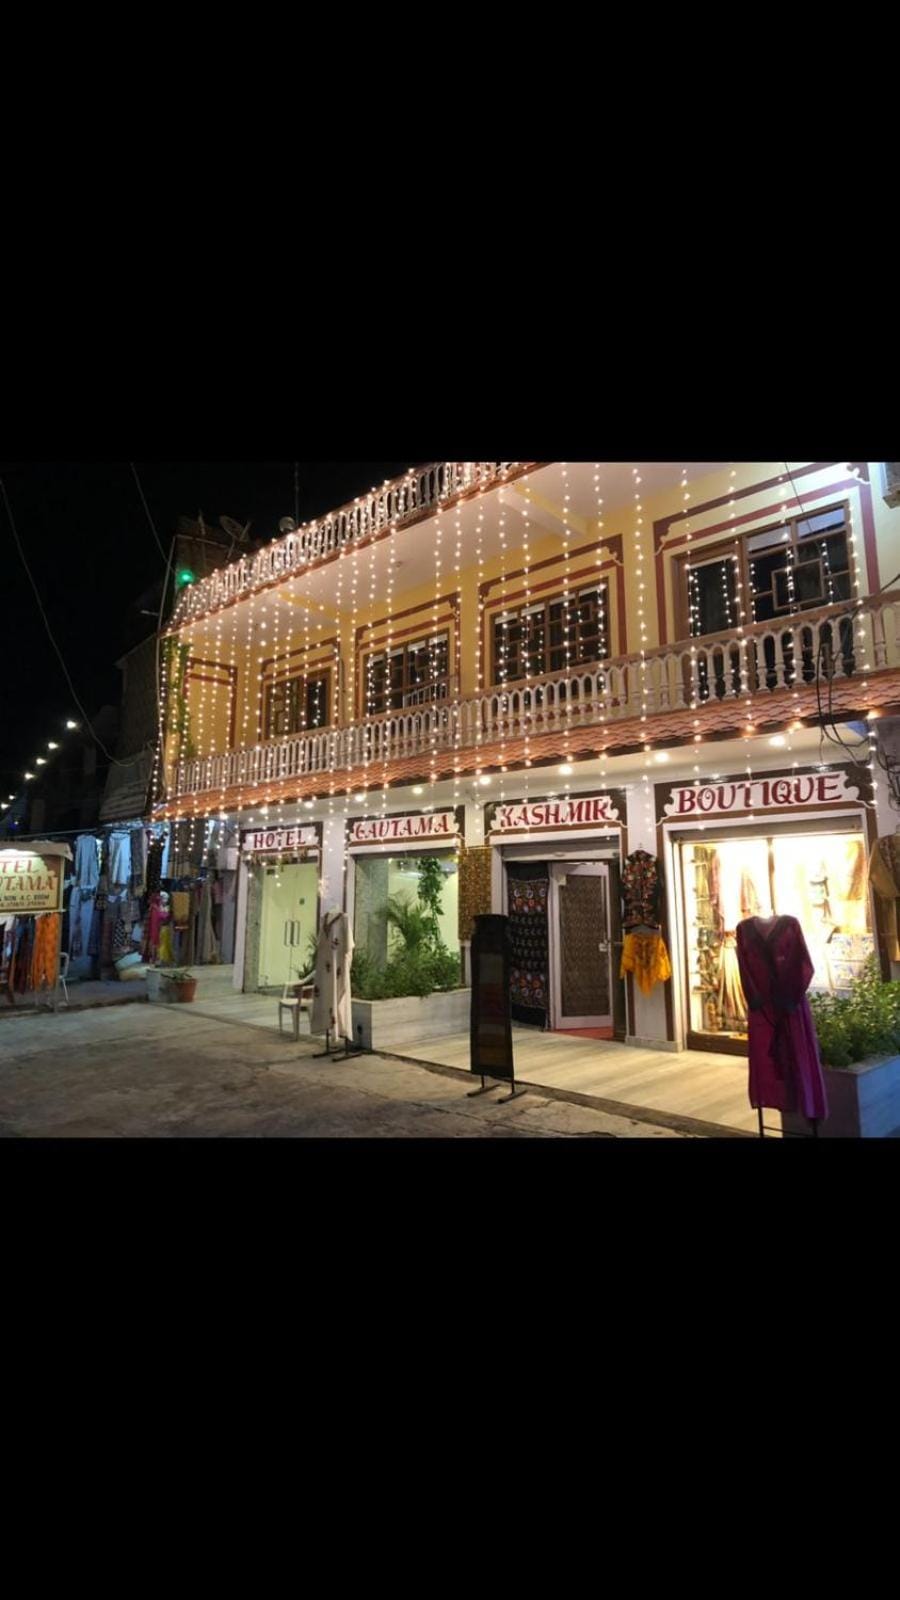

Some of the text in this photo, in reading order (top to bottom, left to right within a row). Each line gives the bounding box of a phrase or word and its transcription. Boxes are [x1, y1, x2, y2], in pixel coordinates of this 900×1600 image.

[676, 775, 842, 814] BOUTIQUE
[500, 799, 610, 827] KASHMIR
[253, 831, 306, 849] HOTEL
[355, 814, 449, 840] GAUTAMA
